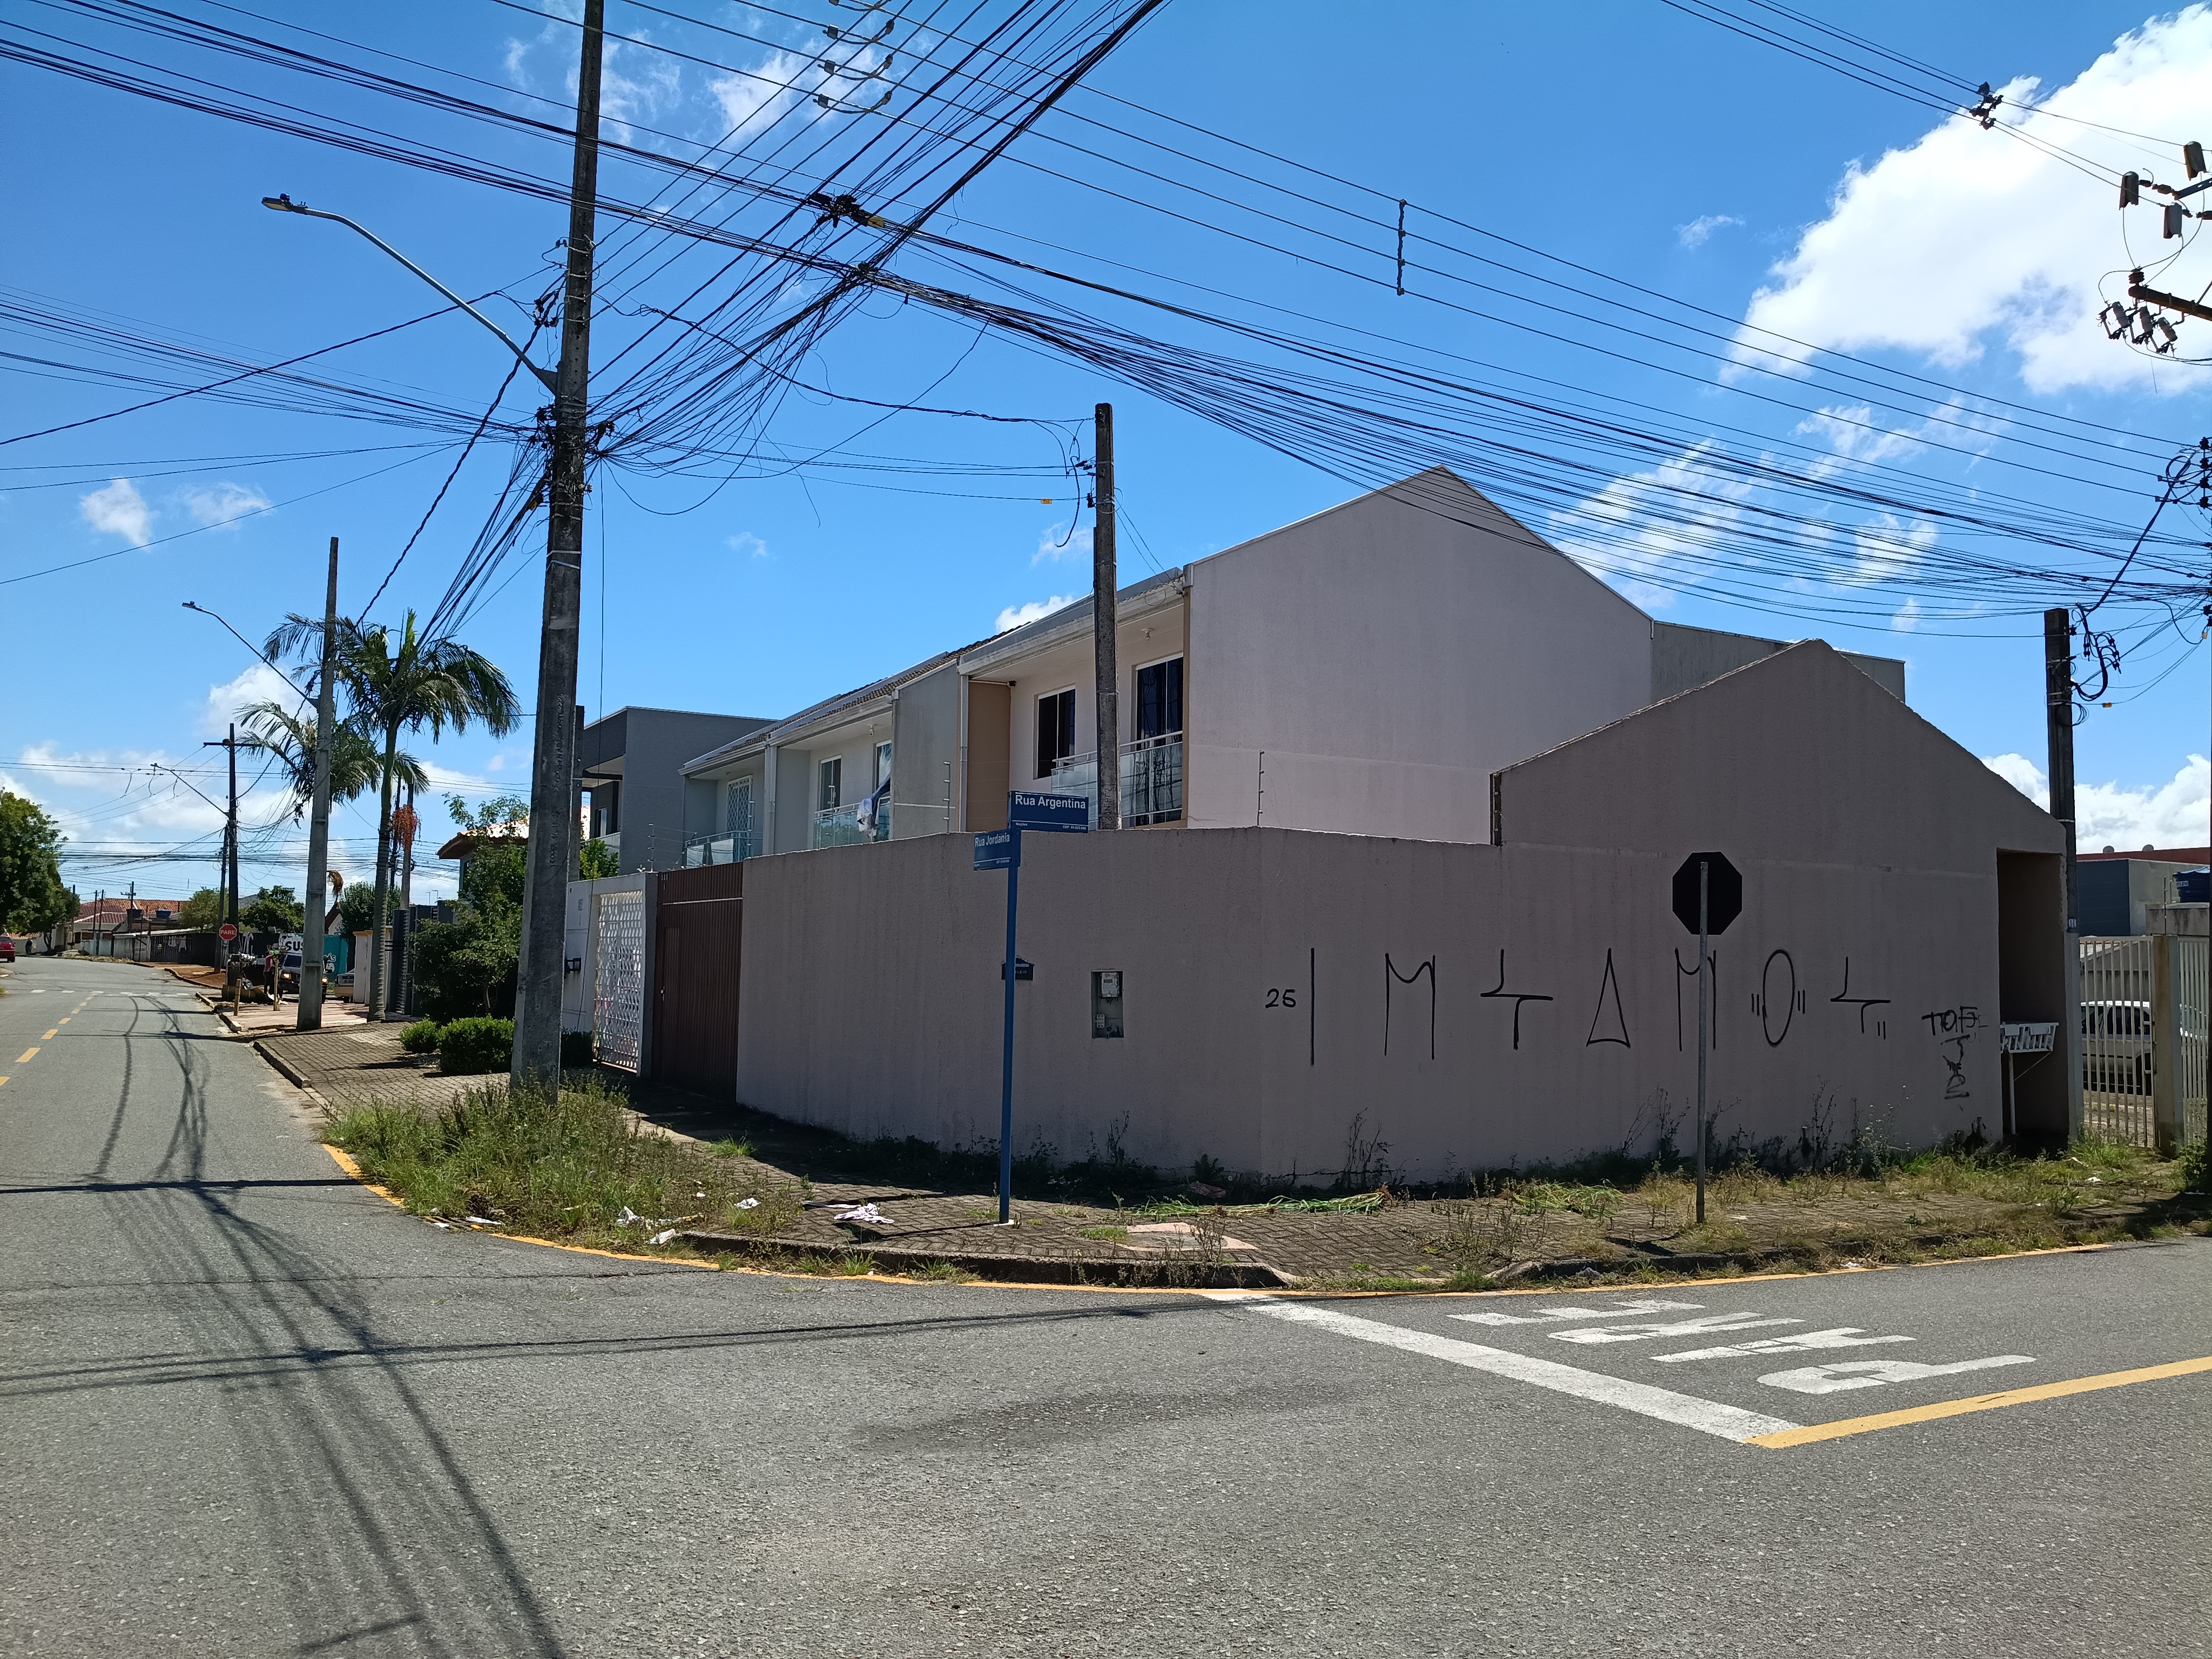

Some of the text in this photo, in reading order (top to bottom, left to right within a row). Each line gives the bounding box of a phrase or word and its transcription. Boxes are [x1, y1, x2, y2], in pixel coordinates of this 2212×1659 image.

[1015, 794, 1086, 810] Rua Argentina
[975, 832, 1010, 847] Rua Jordania
[1265, 988, 1297, 1008] 25
